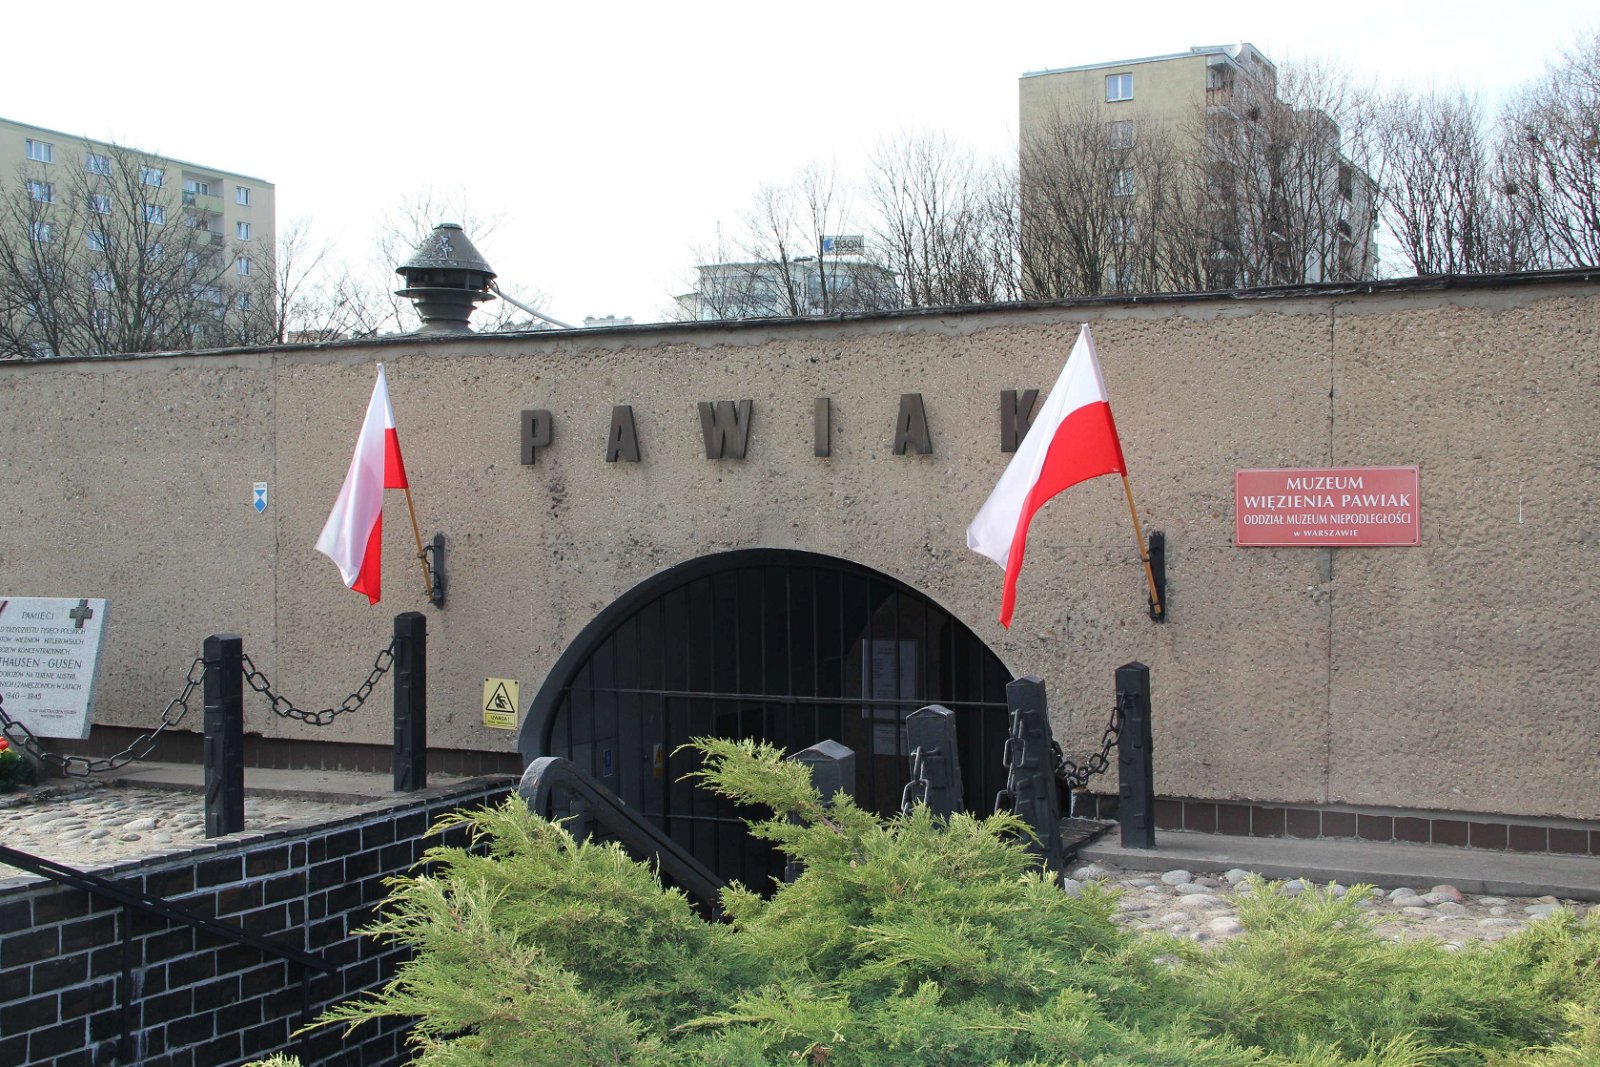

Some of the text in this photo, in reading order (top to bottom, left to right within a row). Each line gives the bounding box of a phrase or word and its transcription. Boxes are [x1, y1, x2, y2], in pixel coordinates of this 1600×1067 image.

[520, 388, 1041, 465] PAWIAK
[1286, 476, 1364, 490] MUZEUM
[1243, 494, 1411, 511] WIĘZIENIA PAWIAK
[1243, 510, 1411, 525] ODDZIAŁ MUZEUM NIEPODLEGŁOŚCI
[1303, 529, 1359, 537] WARSZAWIE
[48, 658, 83, 669] GUSEN
